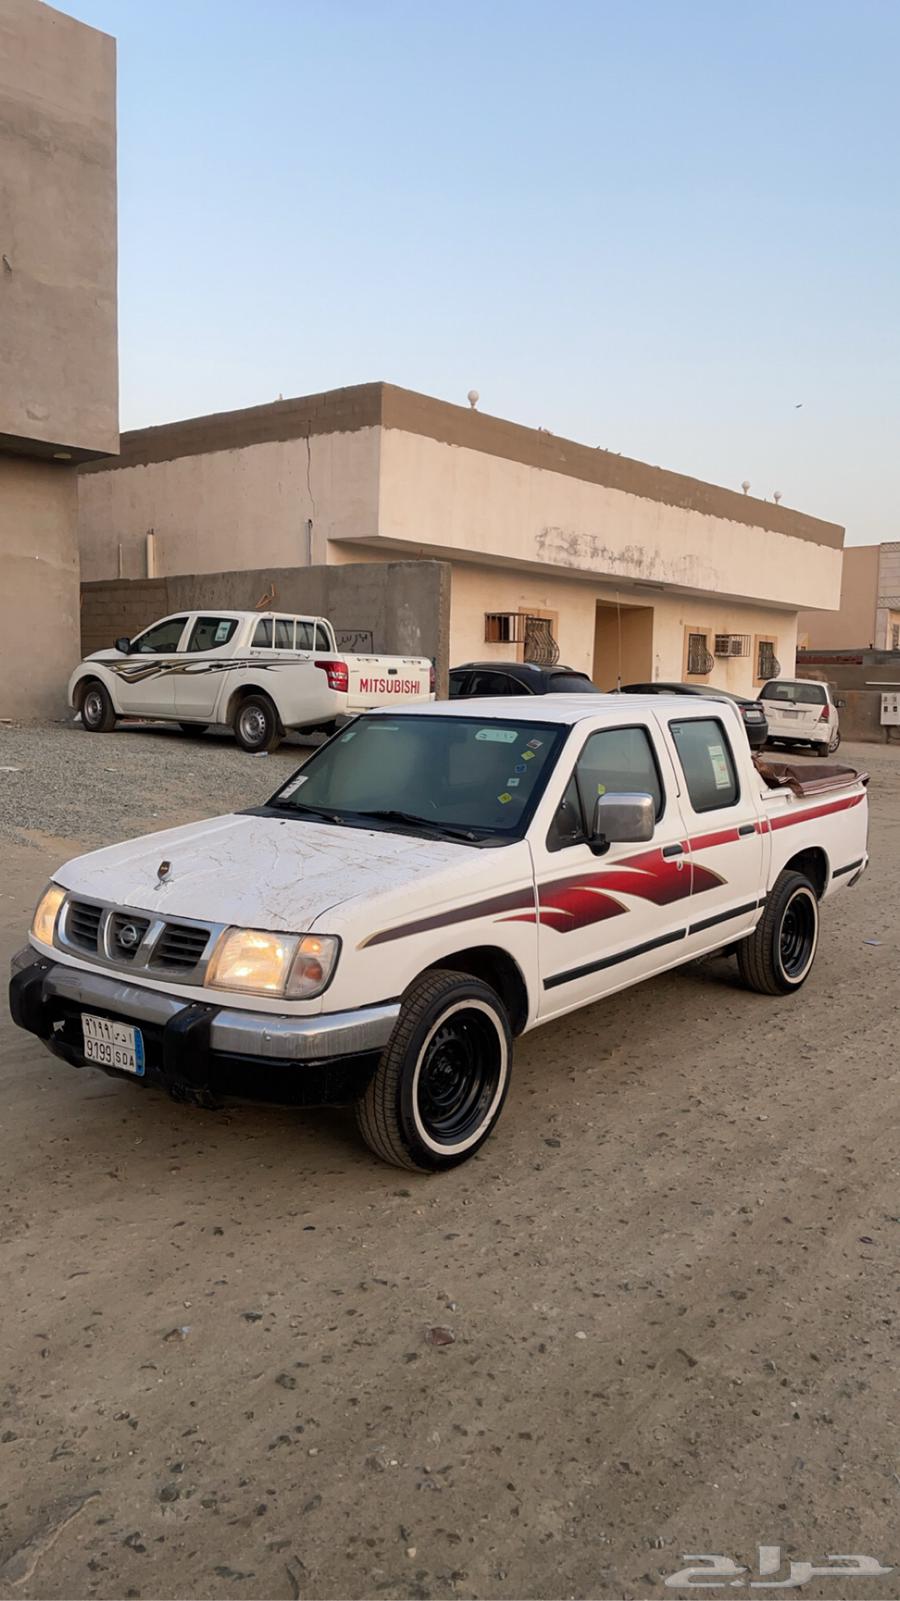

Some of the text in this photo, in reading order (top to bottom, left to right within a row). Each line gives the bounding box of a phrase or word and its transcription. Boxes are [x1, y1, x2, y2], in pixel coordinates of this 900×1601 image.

[360, 679, 420, 694] MITSUBISHI
[87, 1040, 112, 1063] 9199
[115, 1051, 135, 1067] SDA
